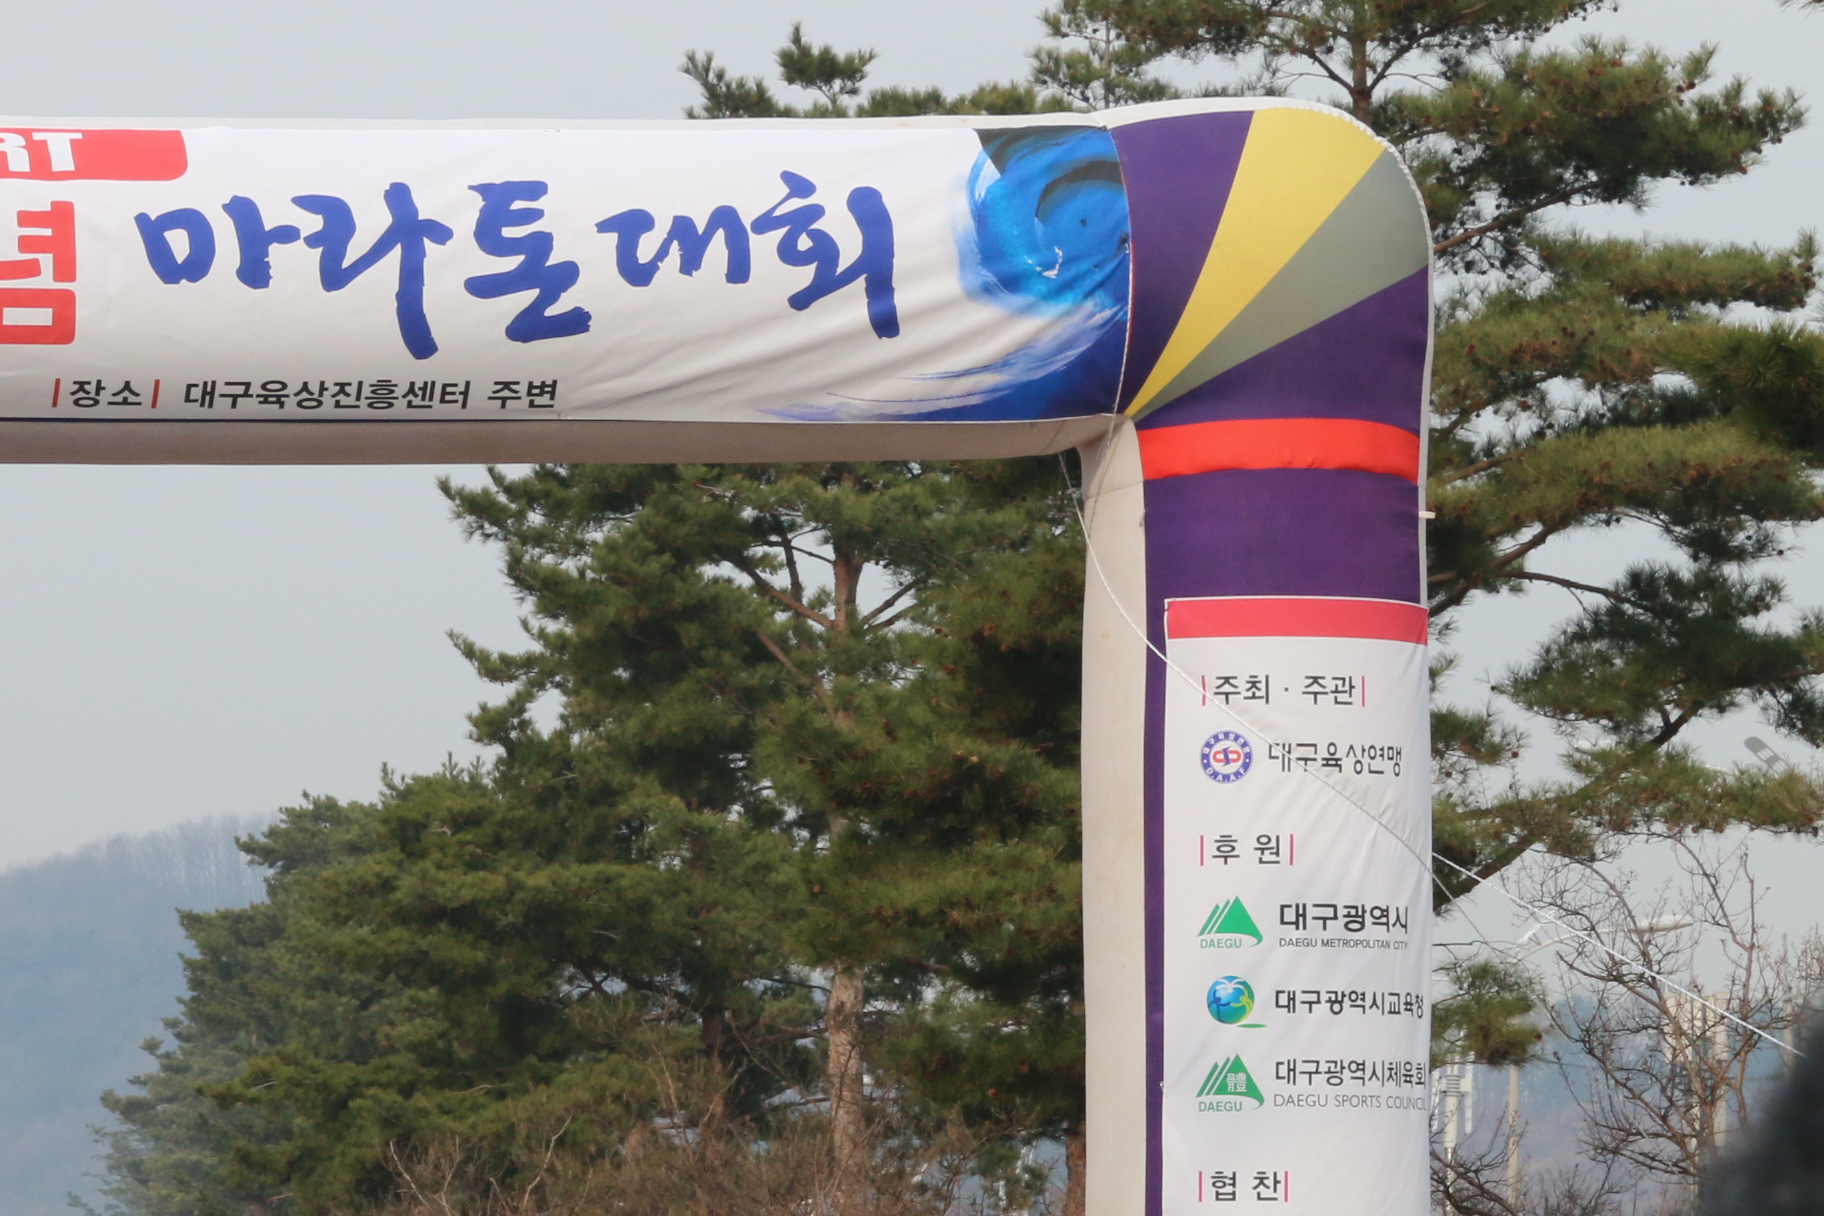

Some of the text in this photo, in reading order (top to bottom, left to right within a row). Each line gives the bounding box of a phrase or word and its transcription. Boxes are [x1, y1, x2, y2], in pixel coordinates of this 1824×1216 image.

[133, 170, 899, 359] 마라톤대회
[68, 379, 144, 410] 장소
[184, 380, 470, 411] 대구육상진흥센터
[486, 379, 558, 410] 주변
[1212, 673, 1356, 706] 주최 주관
[1268, 741, 1402, 777] 대구육상연맹
[1279, 902, 1408, 934] 대구광역시
[1200, 938, 1242, 949] DAEGU
[1279, 937, 1408, 951] DAEGU METROPOLITAN CITY
[1275, 989, 1424, 1019] 대구광역시교육청
[1275, 1059, 1427, 1090] 대구광역시체육회
[1198, 1101, 1242, 1112] DAEGU
[1274, 1093, 1328, 1108] DAEGU
[1334, 1093, 1381, 1109] SPORTS
